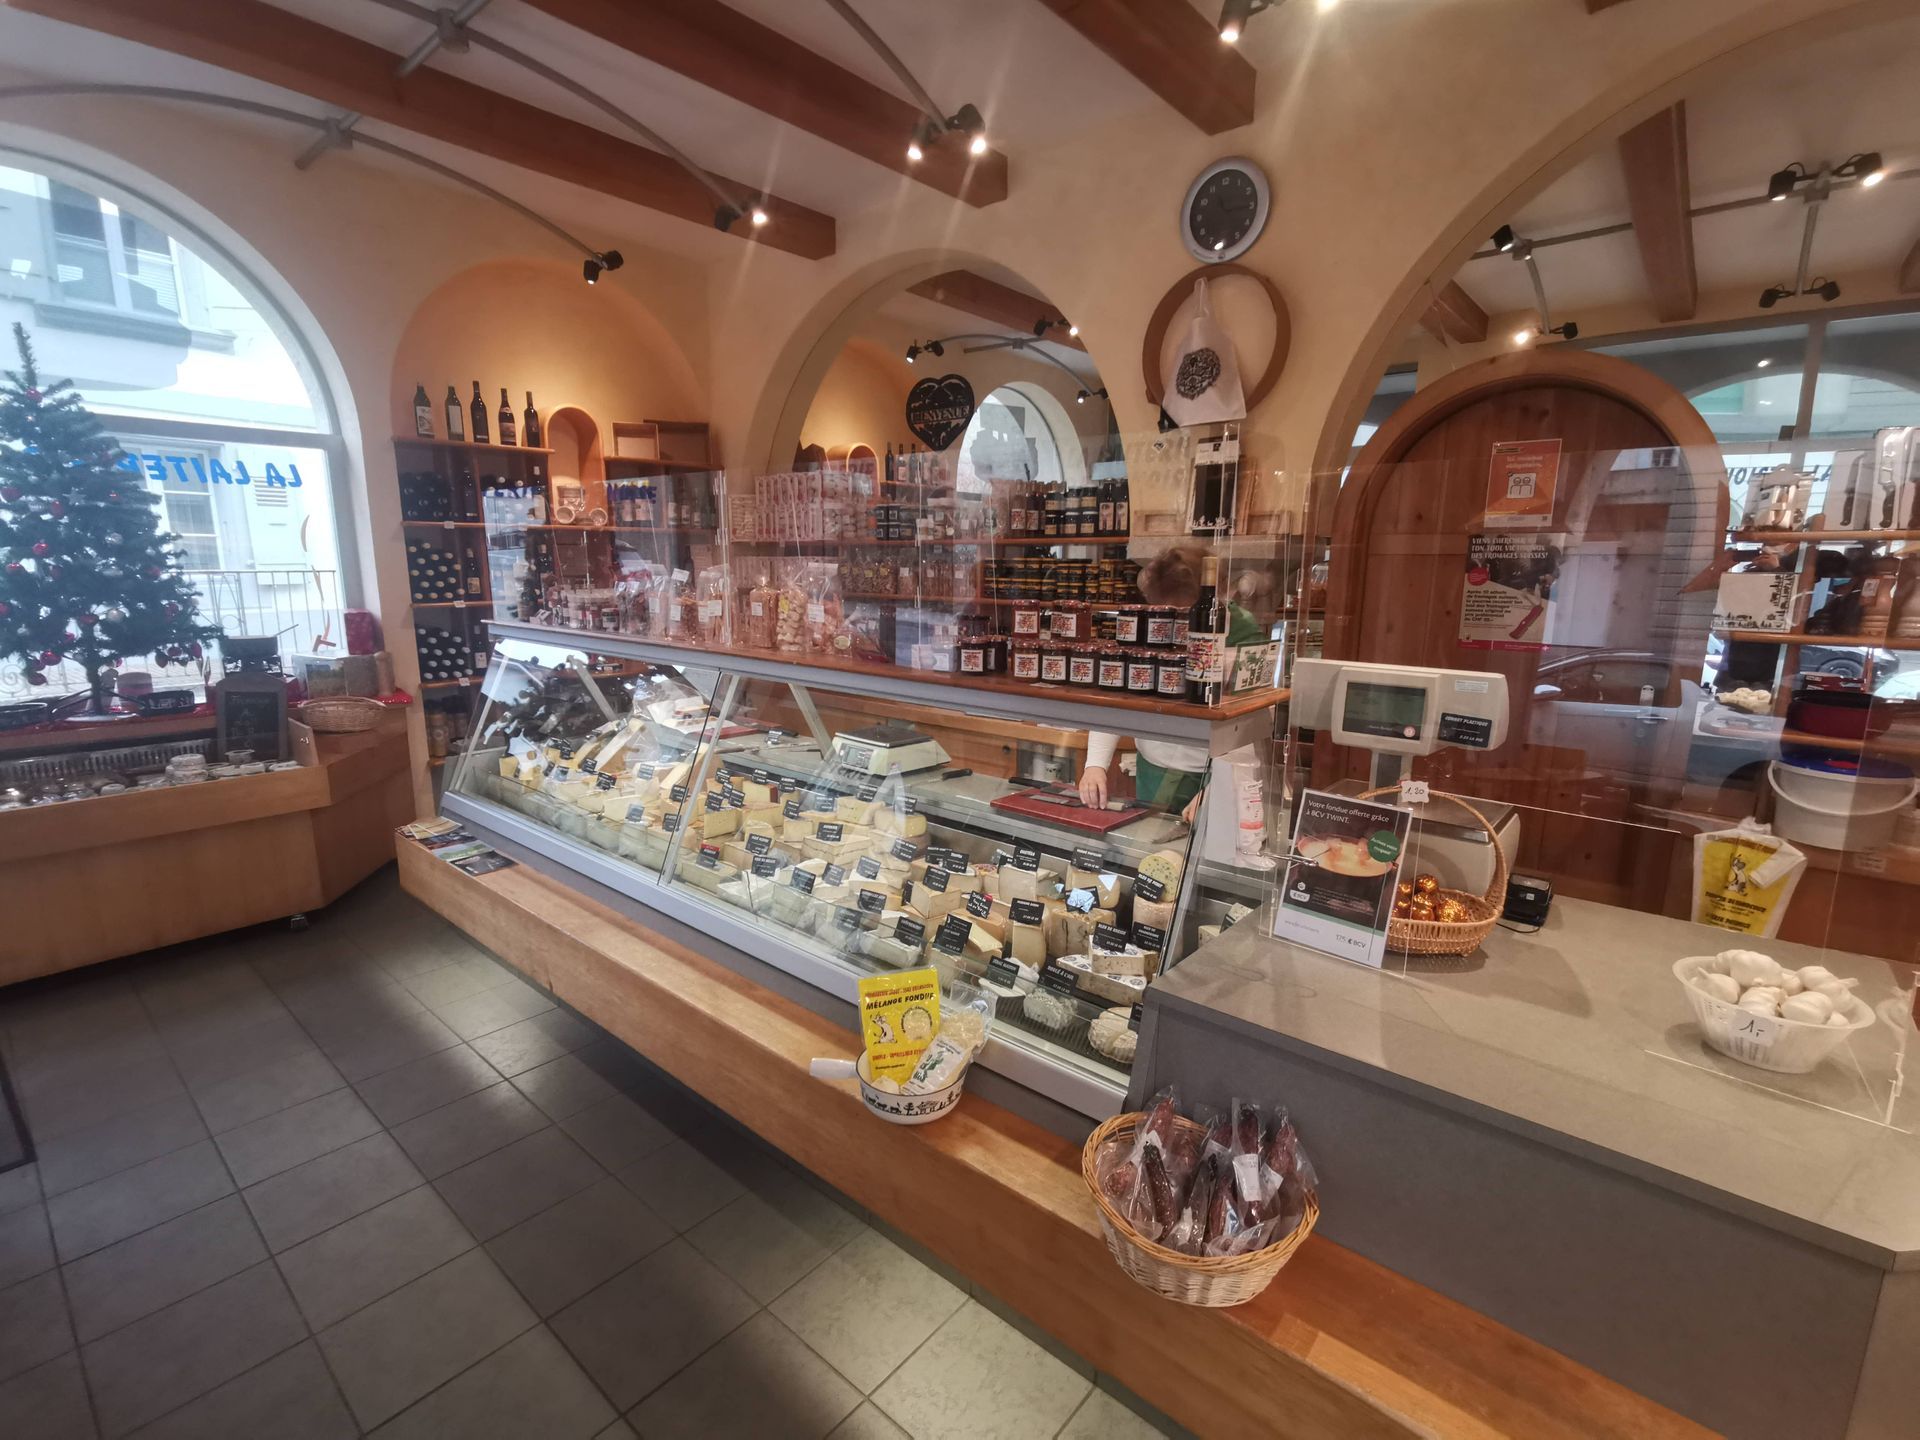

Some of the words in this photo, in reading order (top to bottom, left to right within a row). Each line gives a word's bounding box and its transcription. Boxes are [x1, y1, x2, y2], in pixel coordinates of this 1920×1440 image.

[1222, 177, 1230, 186] 12
[1209, 185, 1216, 193] 11
[1246, 187, 1252, 195] 2
[1200, 198, 1209, 206] 10
[1249, 201, 1255, 210] 3
[1244, 218, 1250, 226] 4
[1234, 231, 1240, 240] 5
[1308, 799, 1325, 810] Votre
[1326, 802, 1348, 814] fondue
[1348, 808, 1371, 819] offerte
[1371, 812, 1390, 823] grâce
[1312, 810, 1325, 819] BCV
[1353, 940, 1366, 949] BCV
[866, 996, 902, 1011] MÉLANGE
